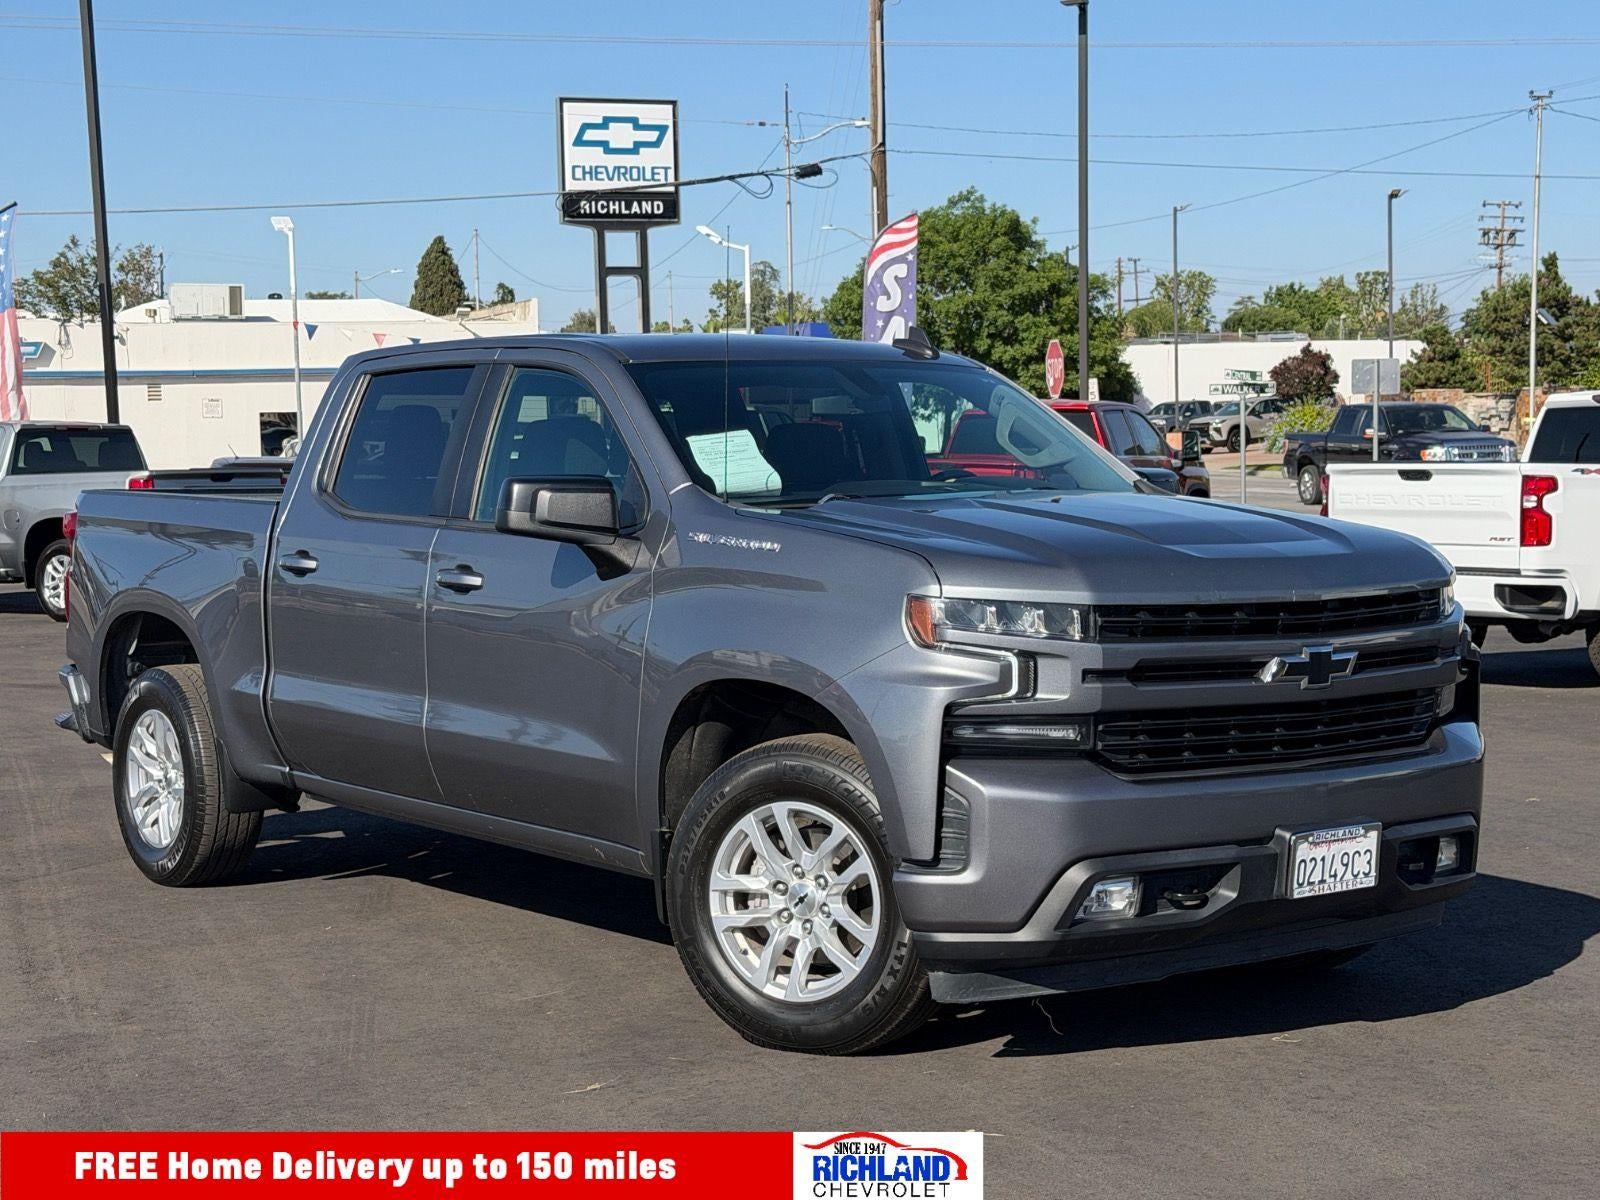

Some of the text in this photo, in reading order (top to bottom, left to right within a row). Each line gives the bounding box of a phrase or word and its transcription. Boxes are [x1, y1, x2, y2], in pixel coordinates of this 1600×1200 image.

[571, 165, 672, 183] CHEVROLET
[580, 200, 664, 215] RICHLAND
[1047, 358, 1062, 379] STOP
[1222, 384, 1261, 395] WALKER
[1339, 493, 1506, 510] CHEVROLET
[687, 532, 781, 553] SILVERADO
[1314, 828, 1361, 841] RICHLAND
[1296, 849, 1373, 887] 02149C3
[1312, 880, 1358, 894] SHAFTER
